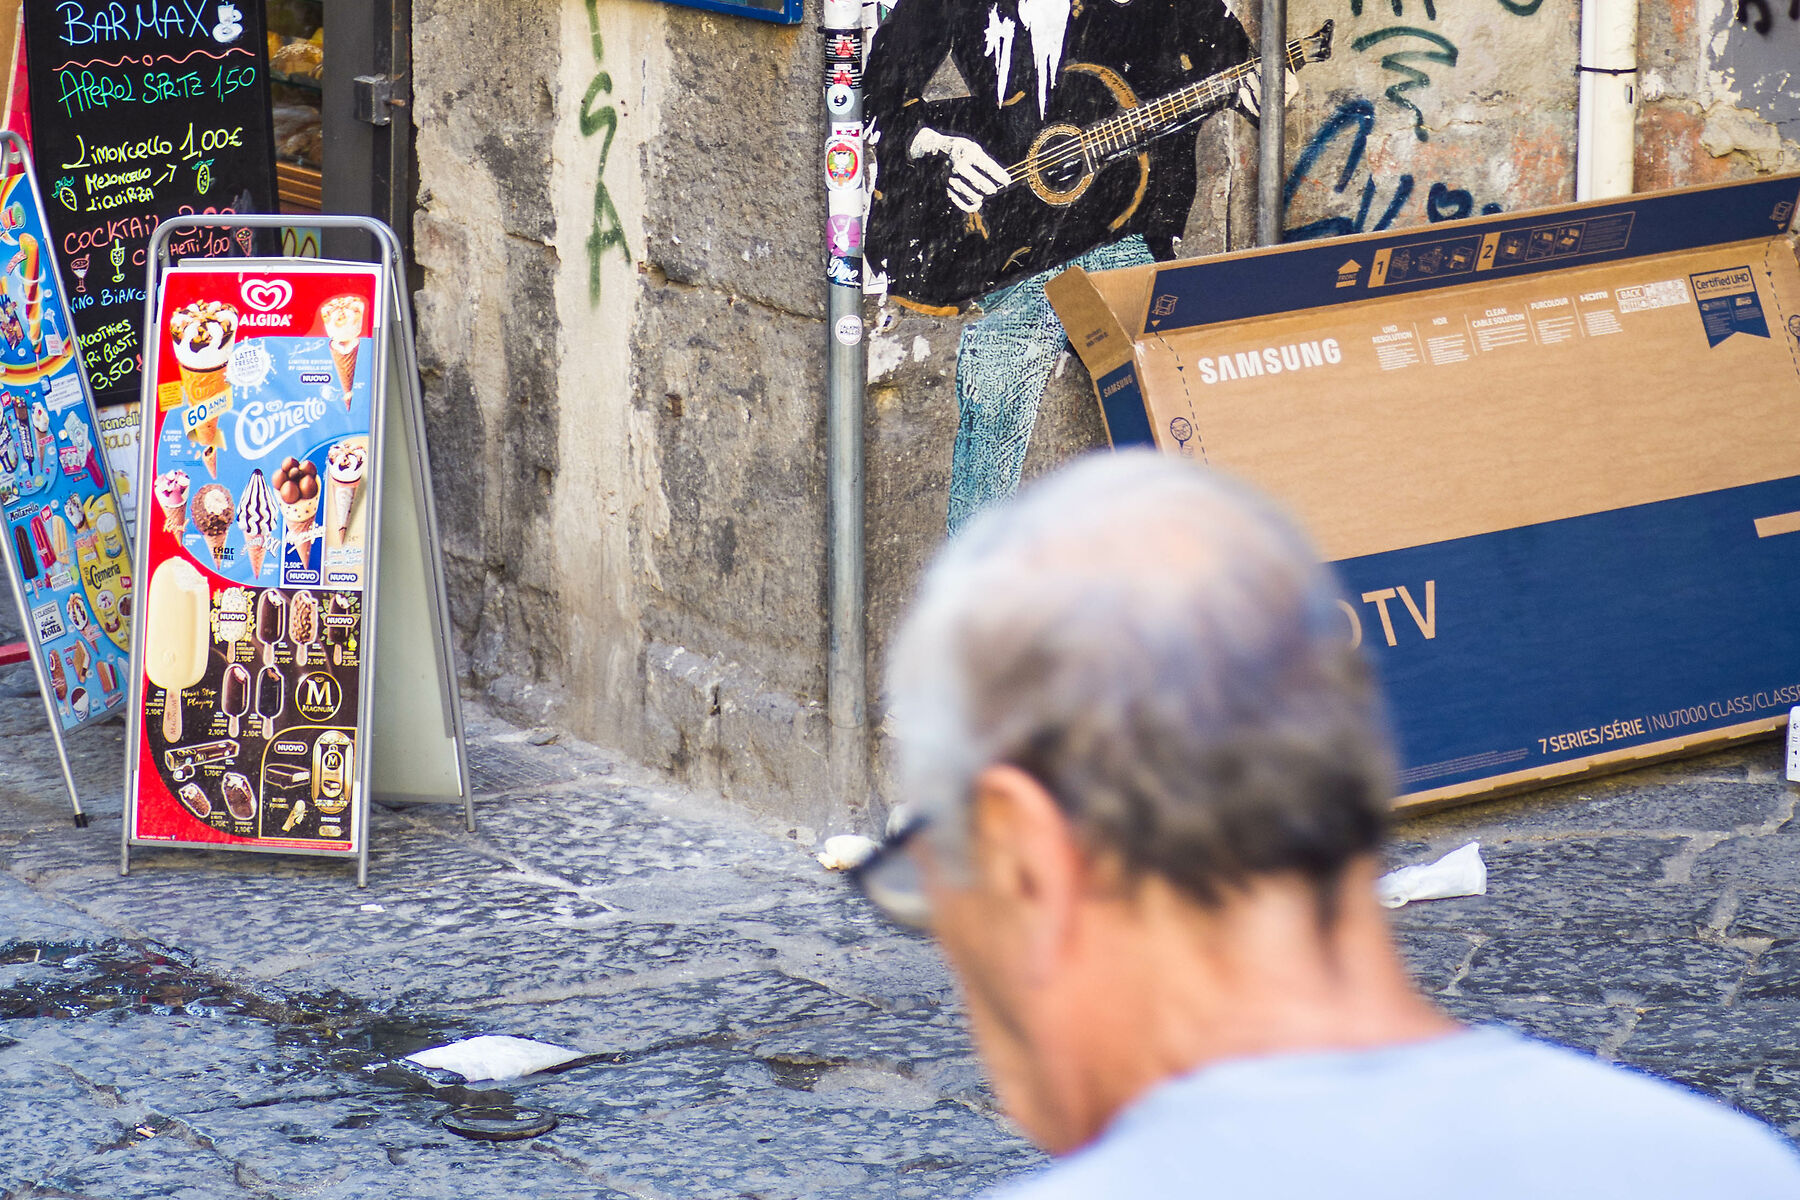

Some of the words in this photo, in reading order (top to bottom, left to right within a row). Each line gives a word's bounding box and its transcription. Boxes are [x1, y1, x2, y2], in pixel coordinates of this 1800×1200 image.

[56, 1, 131, 46] BAR
[211, 65, 256, 103] 1,50
[1377, 261, 1384, 276] 1
[1482, 244, 1494, 259] 2
[1695, 275, 1731, 290] Certified
[1731, 272, 1750, 285] UHD
[1620, 289, 1642, 300] BACK
[239, 314, 291, 327] ALGIDA
[1472, 318, 1494, 328] CABLE
[1493, 313, 1525, 325] SOLUTION
[1485, 308, 1508, 318] CLEAN
[1372, 331, 1413, 345] RESOLUTION
[234, 357, 259, 367] FRESCO
[235, 349, 257, 361] LATTE
[1198, 337, 1342, 385] SAMSUNG
[90, 357, 134, 390] 3,50
[302, 375, 330, 383] NUOVO
[1103, 374, 1134, 399] SAMSUNG
[99, 411, 140, 432] oncell
[187, 404, 208, 427] 60
[234, 396, 327, 461] Cornetto
[289, 572, 316, 580] NUOVO
[329, 573, 357, 582] NUOVO
[219, 613, 246, 621] NUOVO
[326, 616, 354, 625] NUOVO
[1361, 580, 1436, 647] TV
[305, 678, 332, 706] M
[302, 704, 335, 714] MAGNUM
[1538, 739, 1548, 755] 7
[1549, 718, 1646, 753] SERIES/SÉRIE
[1651, 704, 1708, 732] NU7000
[277, 743, 305, 752] NUOVO
